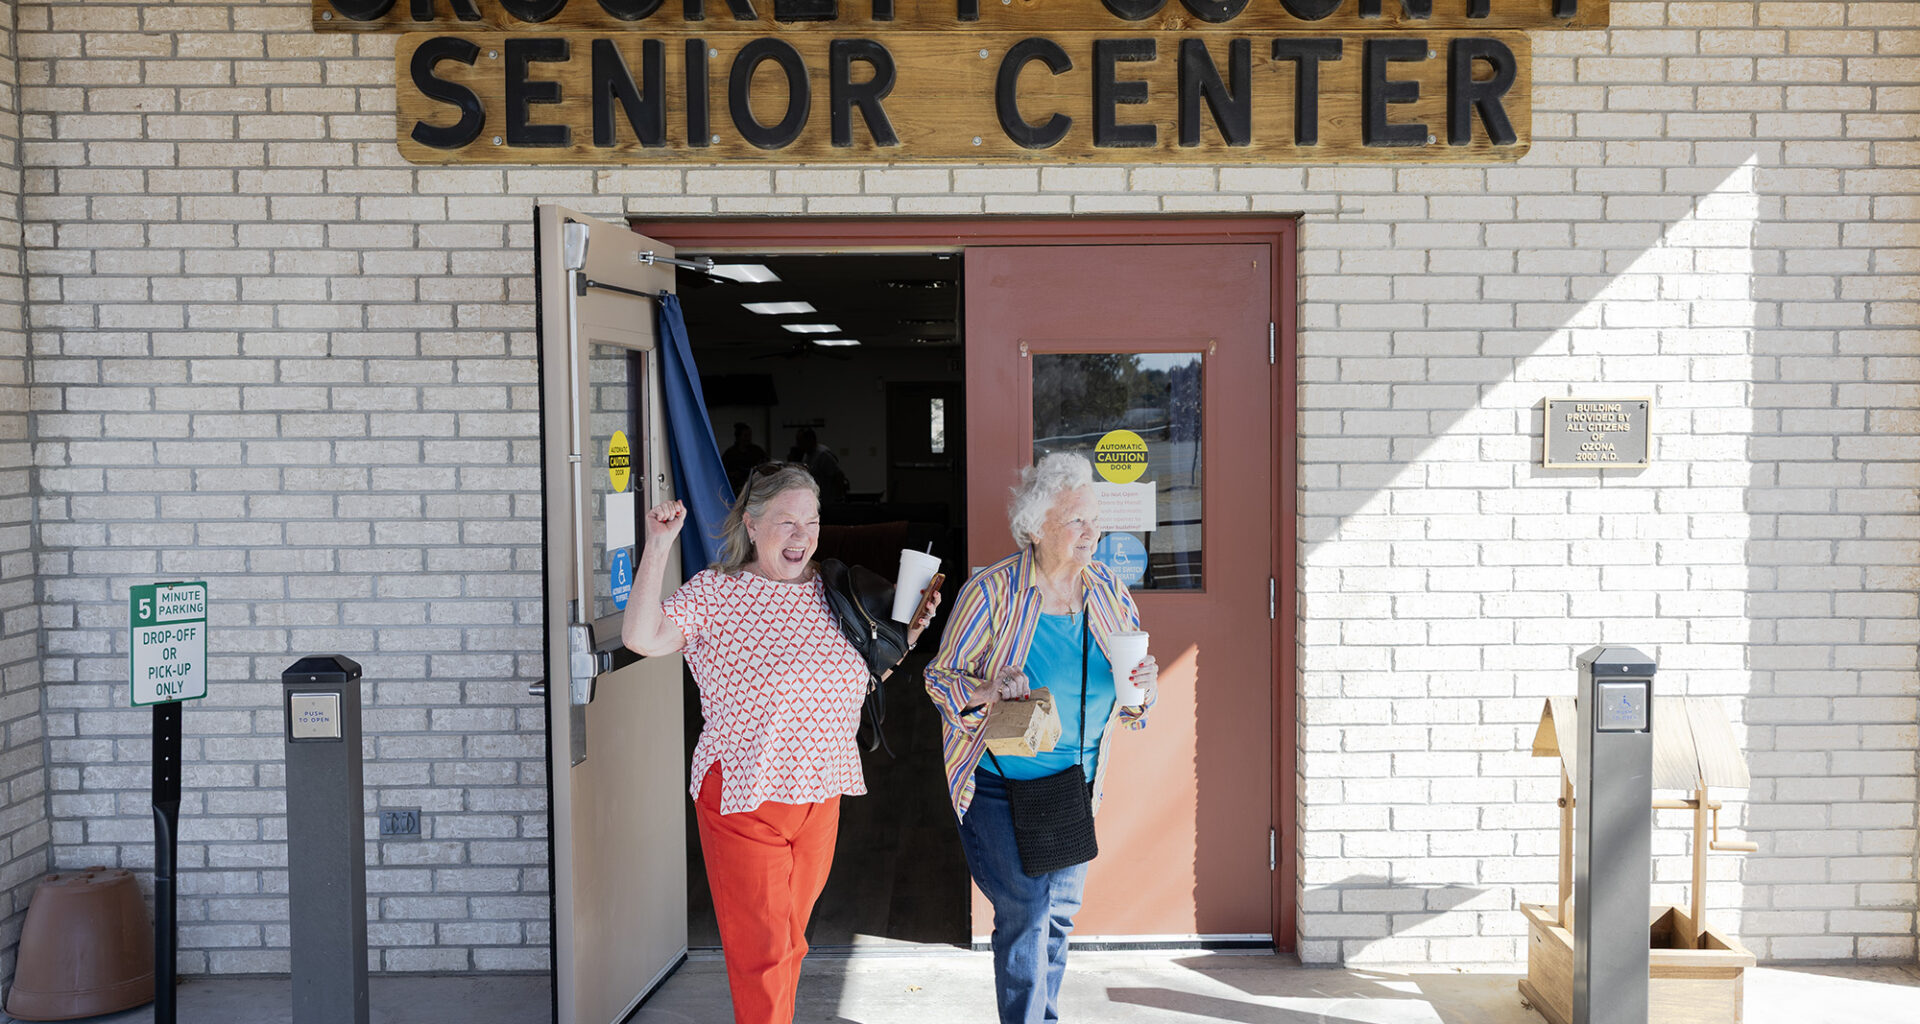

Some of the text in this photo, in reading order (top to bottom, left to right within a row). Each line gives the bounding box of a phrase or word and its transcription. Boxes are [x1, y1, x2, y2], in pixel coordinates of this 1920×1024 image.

[410, 36, 1518, 150] SENIOR CENTER
[1575, 404, 1622, 412] BUILDING
[1566, 413, 1632, 422] PROVIDED BY
[1566, 423, 1631, 432] ALL CITIZENS
[1591, 433, 1605, 441] OF
[1581, 443, 1615, 451] OZONA
[610, 456, 629, 467] CAUTION
[1097, 453, 1145, 462] CAUTION
[1576, 453, 1619, 461] 2000 A.D.
[161, 591, 201, 602] MINUTE
[139, 598, 151, 619] 5
[158, 603, 204, 615] PARKING
[143, 628, 196, 645] DROP-OFF
[162, 647, 177, 660] OR
[148, 663, 192, 679] PICK-UP
[156, 681, 184, 696] ONLY
